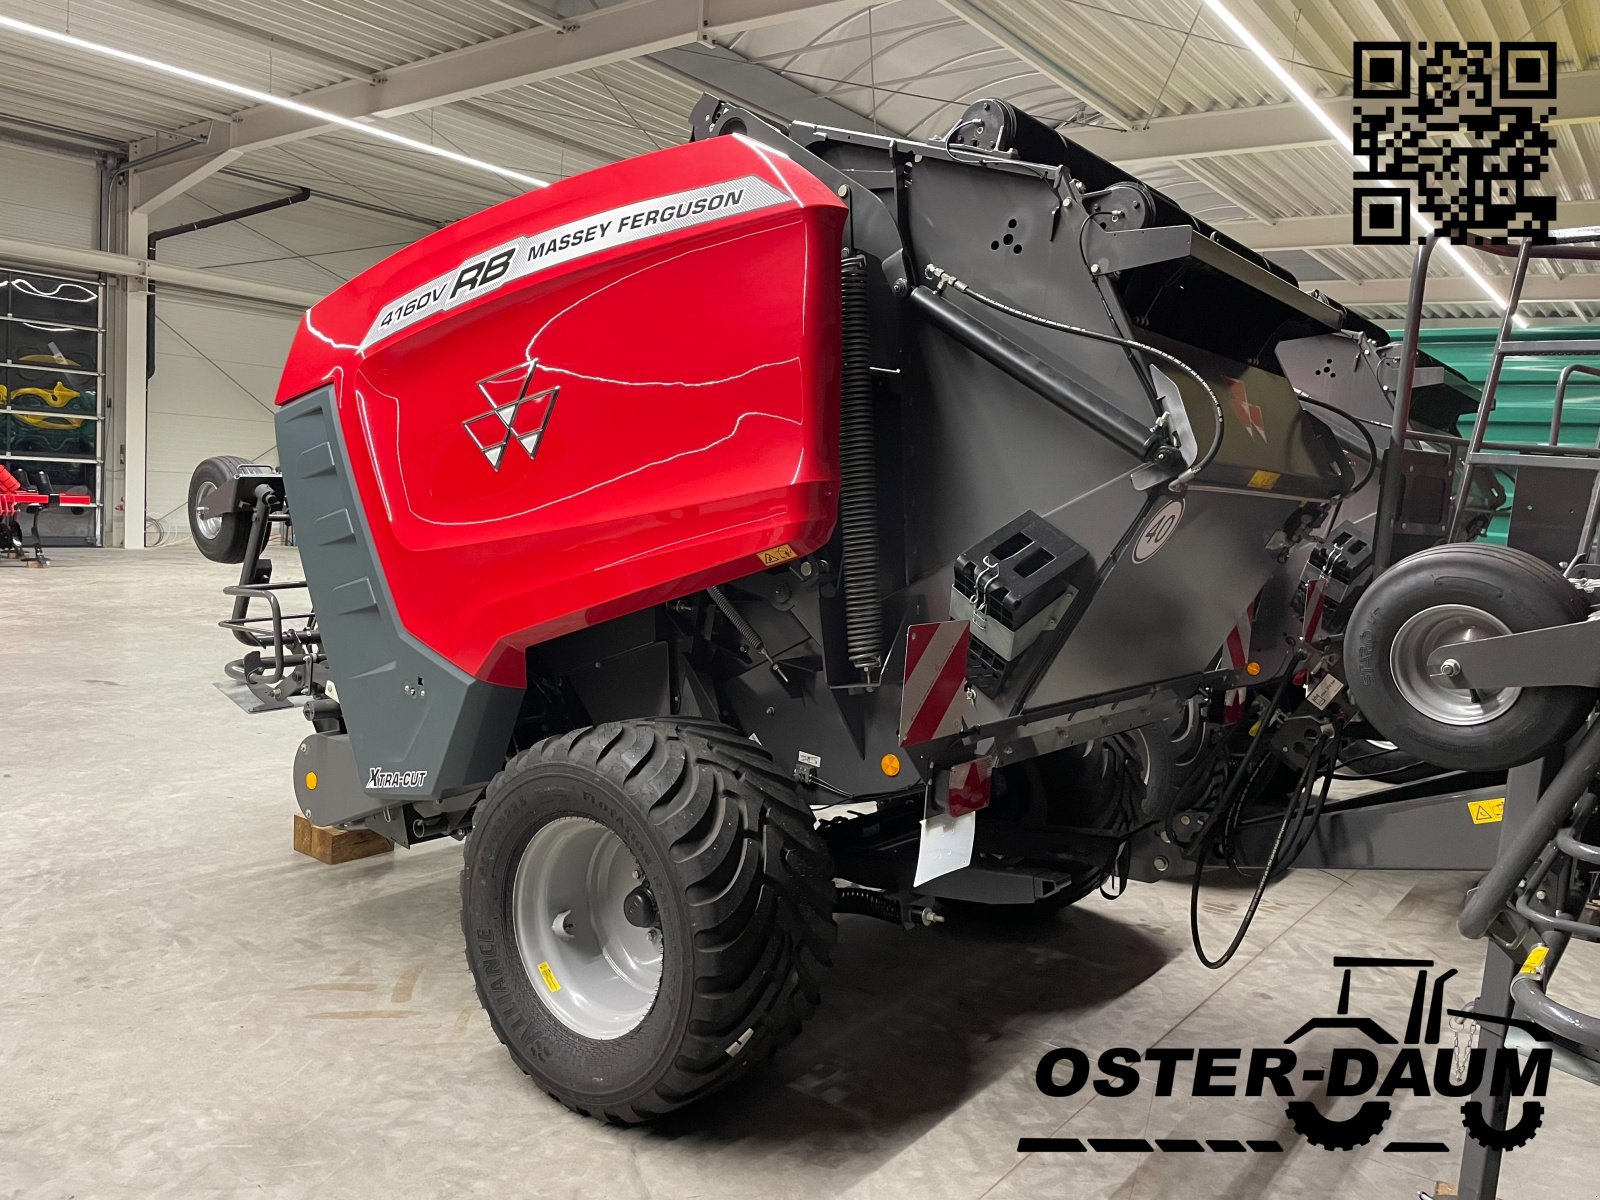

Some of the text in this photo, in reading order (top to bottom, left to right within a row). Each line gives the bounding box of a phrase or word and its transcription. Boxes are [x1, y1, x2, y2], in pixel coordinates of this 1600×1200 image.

[380, 189, 744, 328] 4160V RB MASSEY FERGUSON
[1145, 514, 1176, 543] 40
[366, 767, 427, 788] XTRA-CUT
[477, 928, 544, 1045] ALLIANCE
